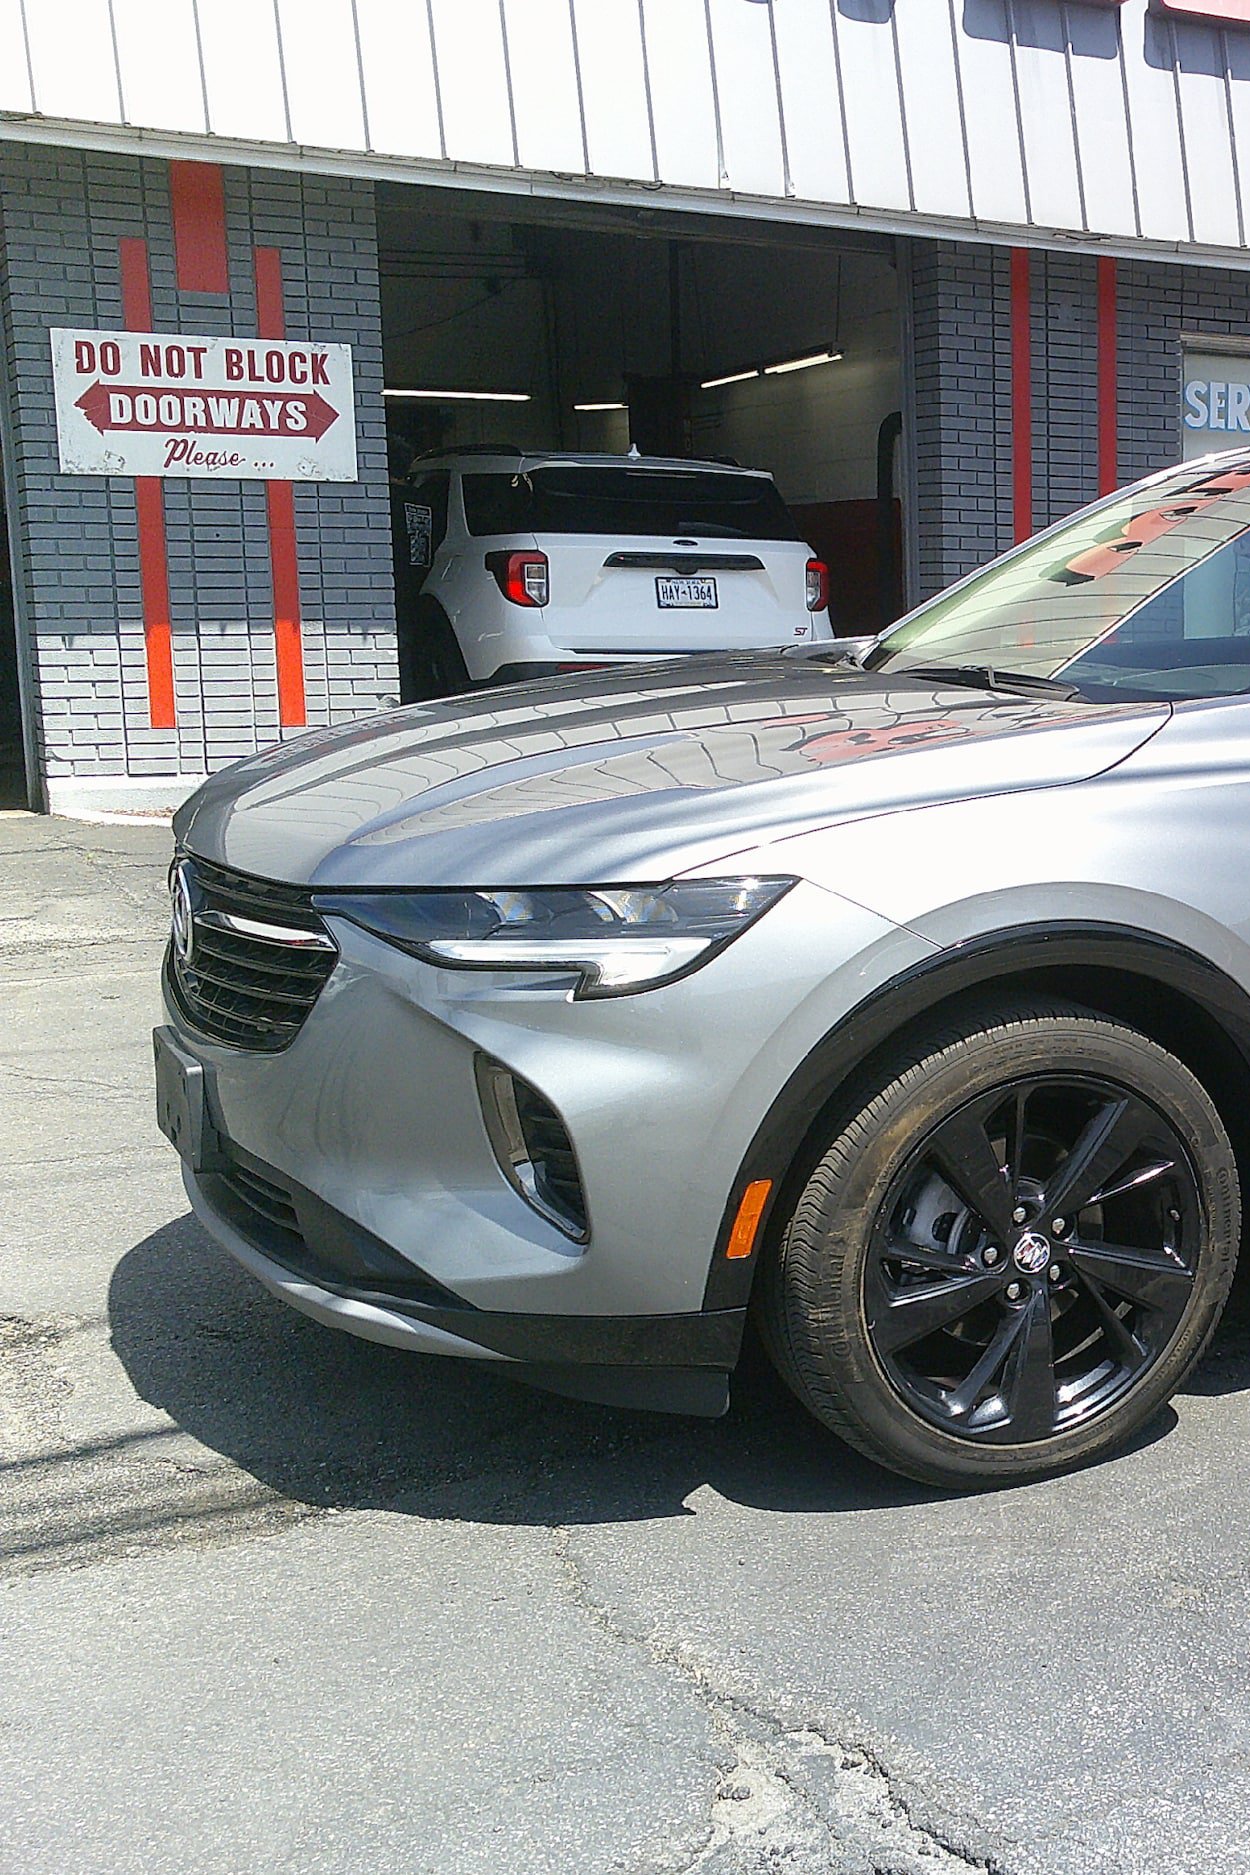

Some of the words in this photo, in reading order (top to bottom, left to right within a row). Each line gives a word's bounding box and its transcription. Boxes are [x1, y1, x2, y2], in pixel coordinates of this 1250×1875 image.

[74, 340, 121, 376] DO
[140, 343, 207, 379] NOT
[225, 348, 331, 385] BLOCK
[108, 392, 308, 431] DOORWAYS
[163, 438, 246, 468] Please
